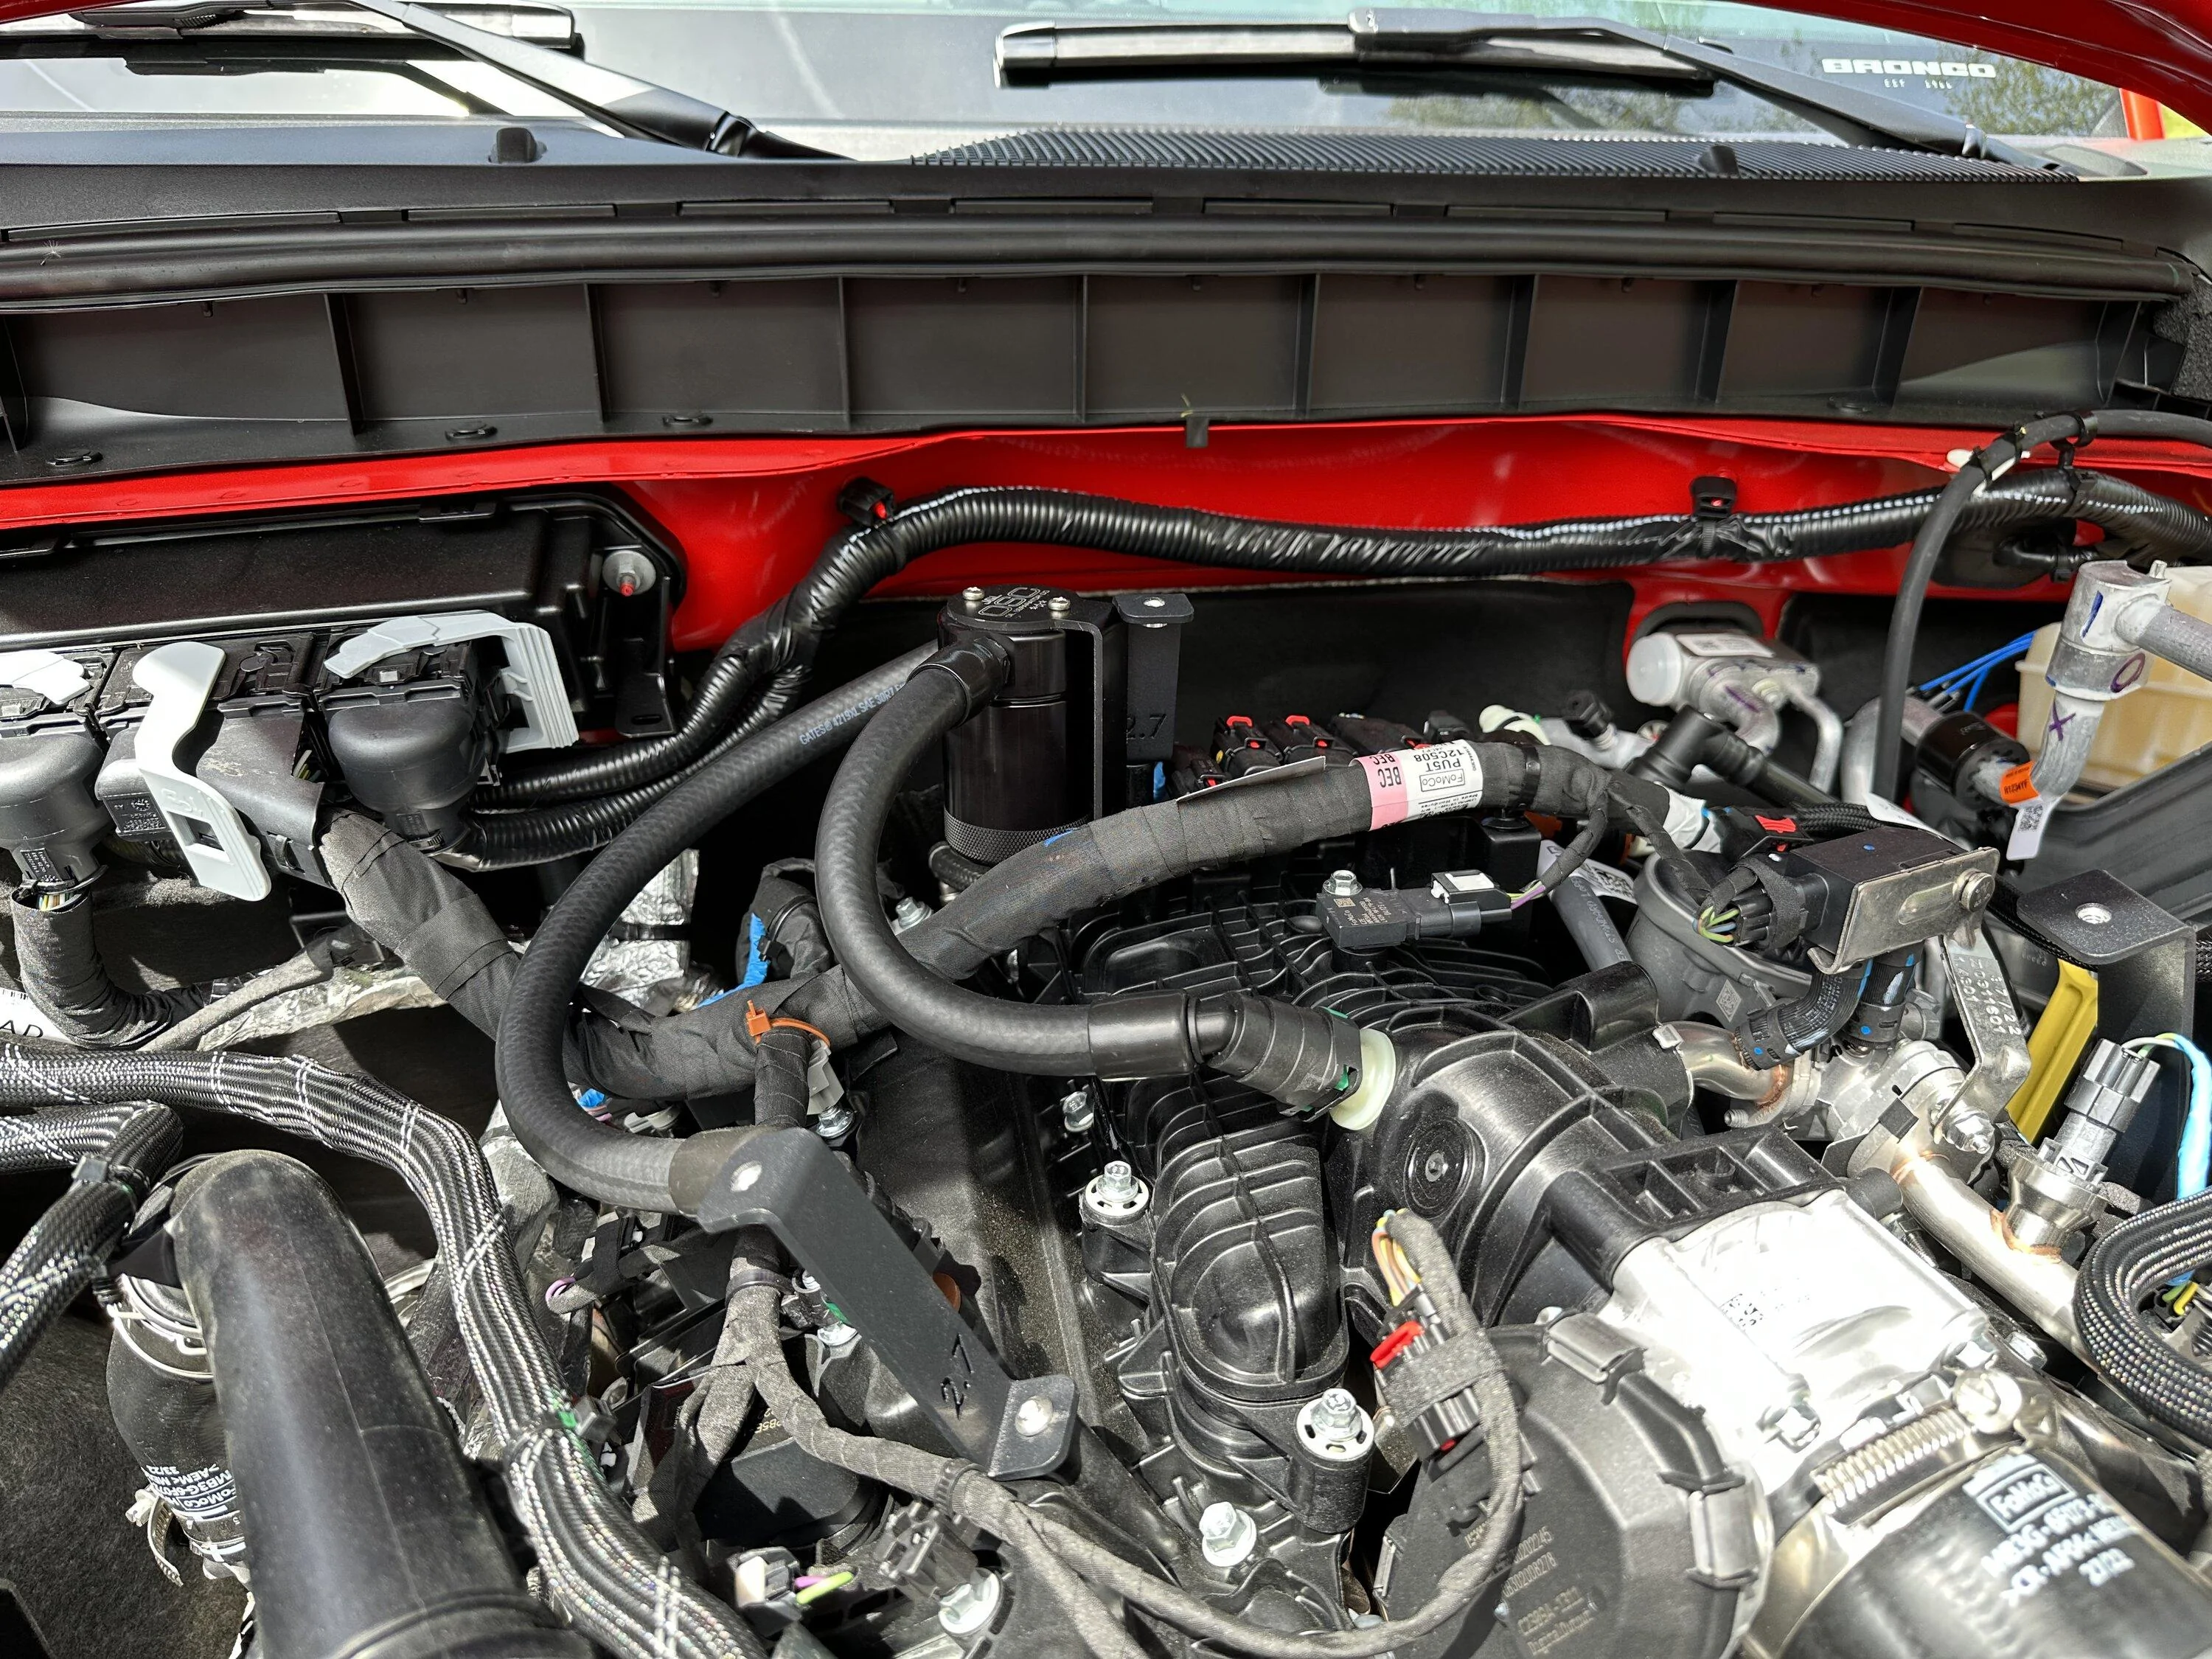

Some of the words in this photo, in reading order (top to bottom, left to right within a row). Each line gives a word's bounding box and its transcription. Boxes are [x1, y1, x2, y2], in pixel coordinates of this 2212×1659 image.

[1822, 58, 1997, 78] BRONCO
[858, 697, 877, 712] SAE
[1413, 748, 1464, 762] 12C508
[1425, 758, 1461, 773] PU5T
[1377, 766, 1402, 788] BEC
[1422, 774, 1464, 787] FoMoCo
